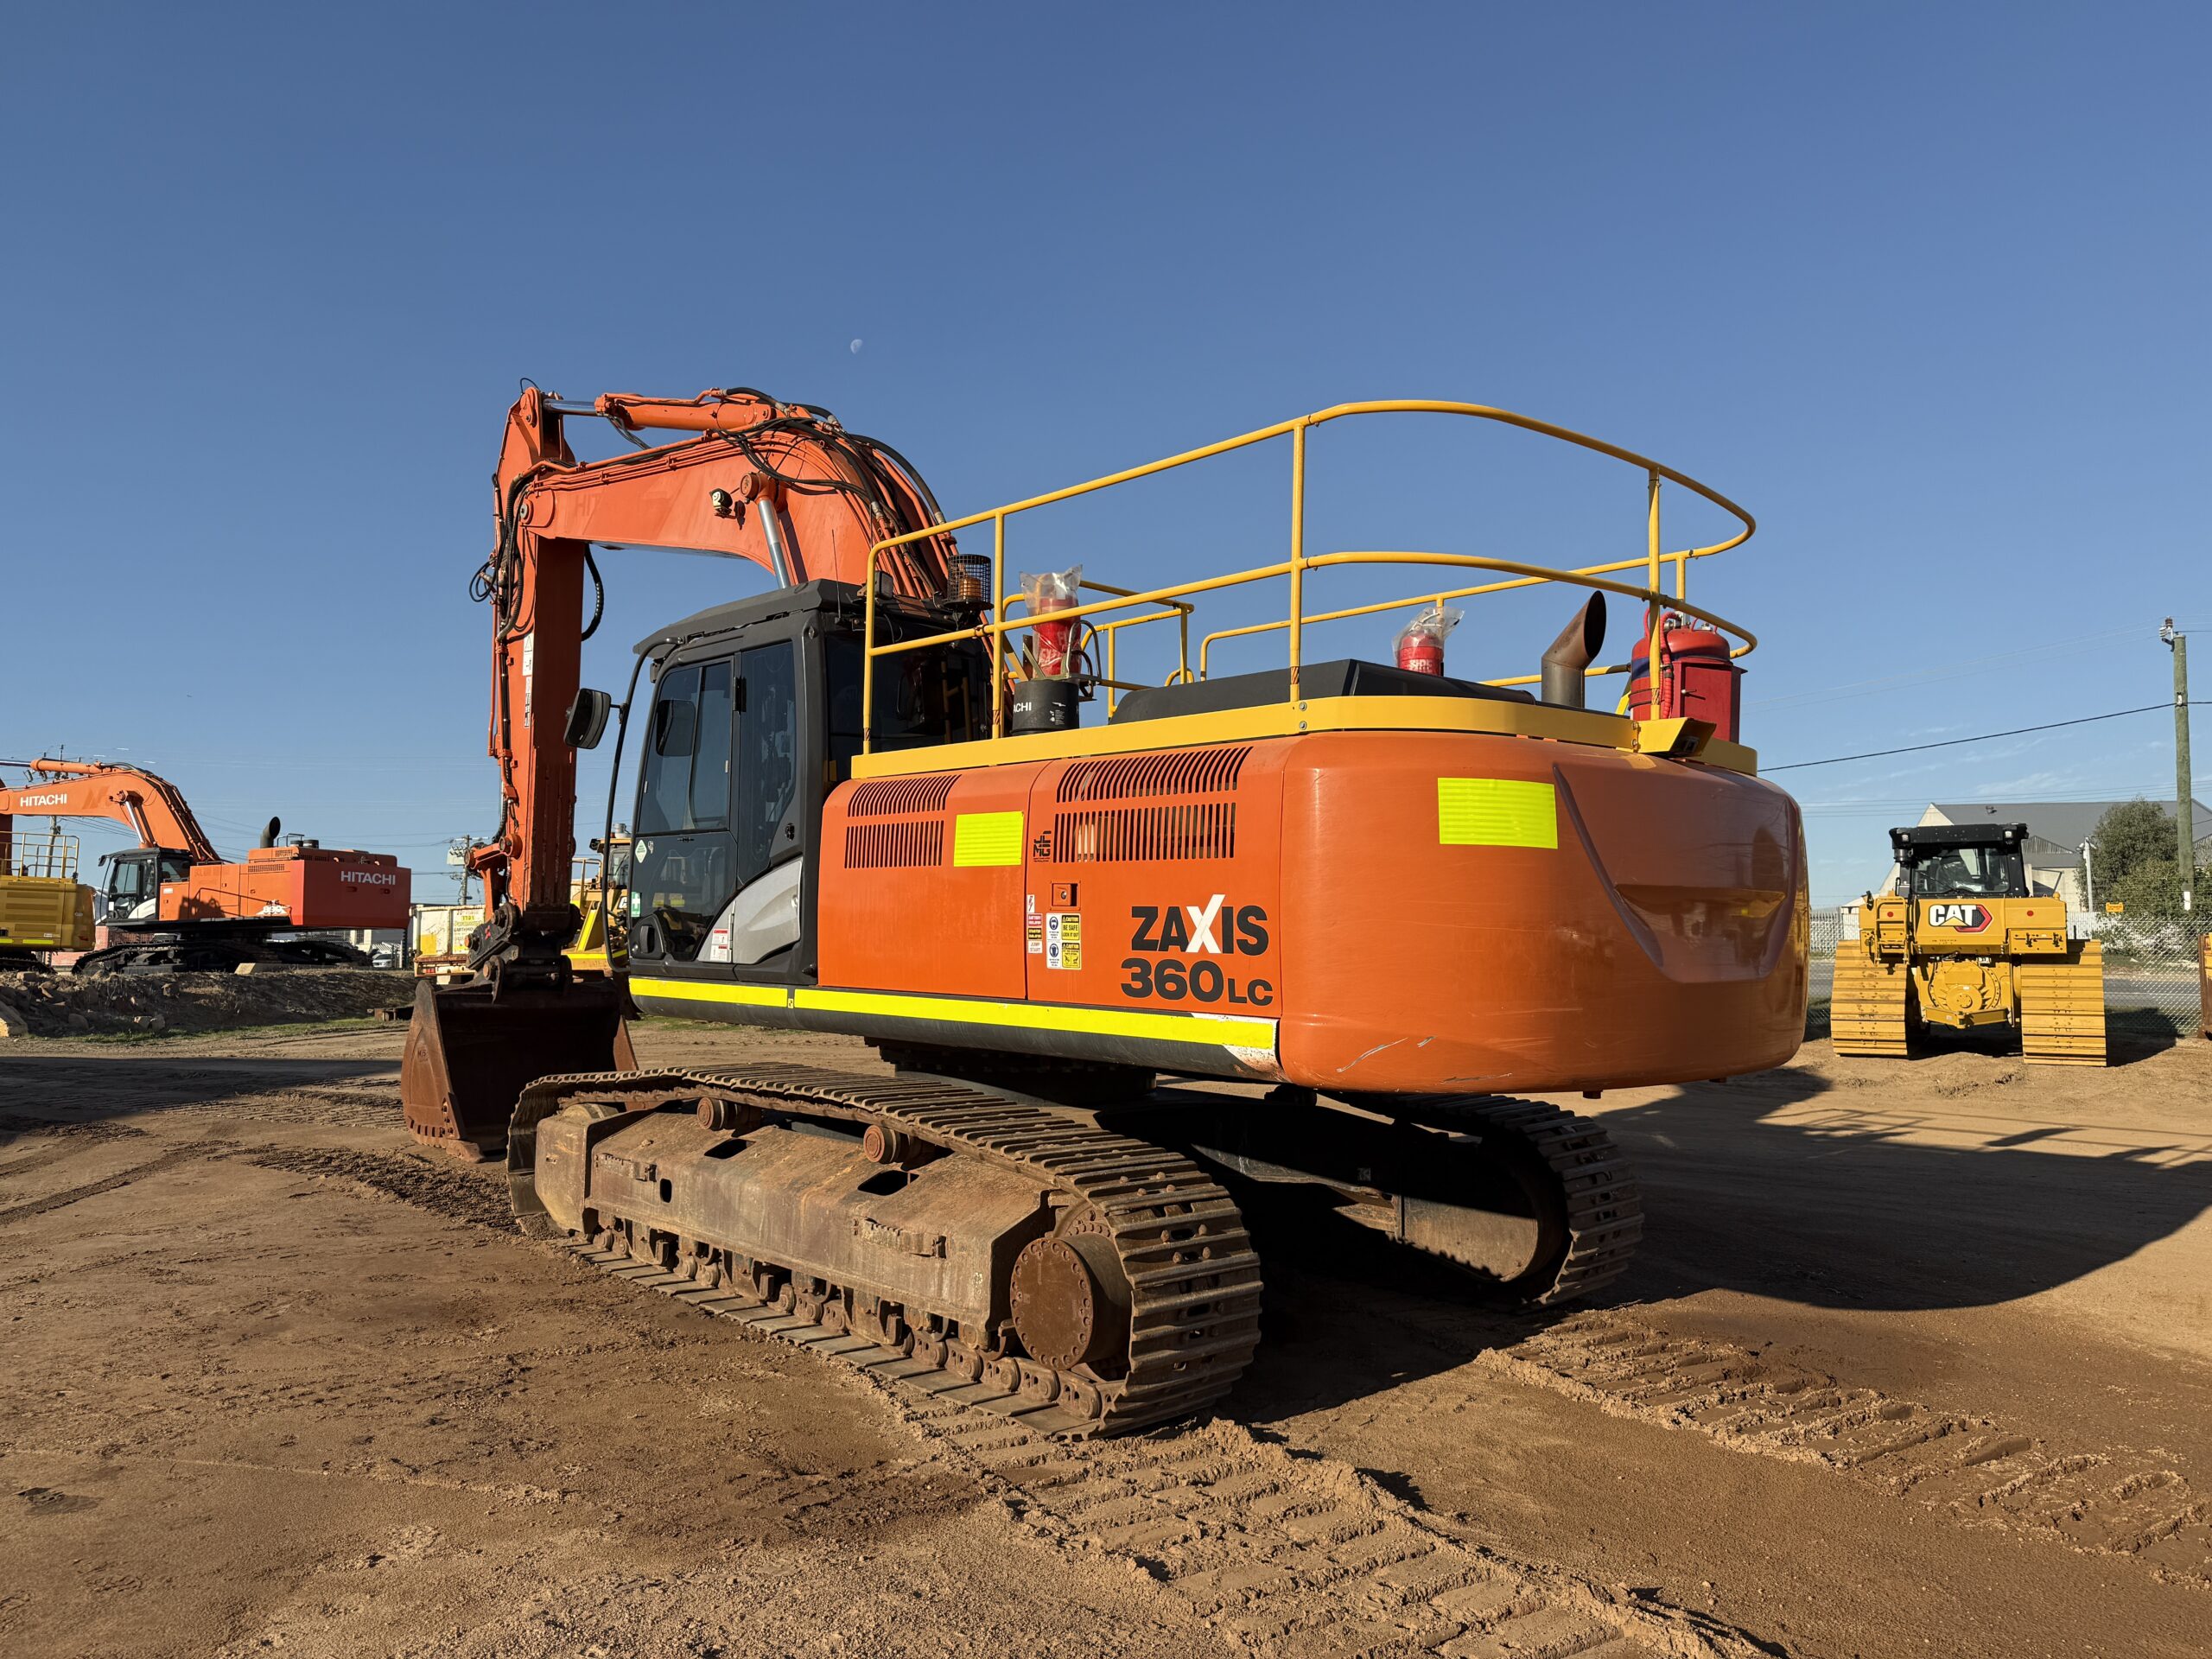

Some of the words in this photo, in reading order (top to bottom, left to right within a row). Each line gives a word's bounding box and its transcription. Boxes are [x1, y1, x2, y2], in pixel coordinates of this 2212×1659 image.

[20, 793, 67, 807] HITACHI
[340, 870, 396, 885] HITACHI
[1929, 905, 1976, 927] CAT
[1131, 894, 1269, 957] ZAXIS
